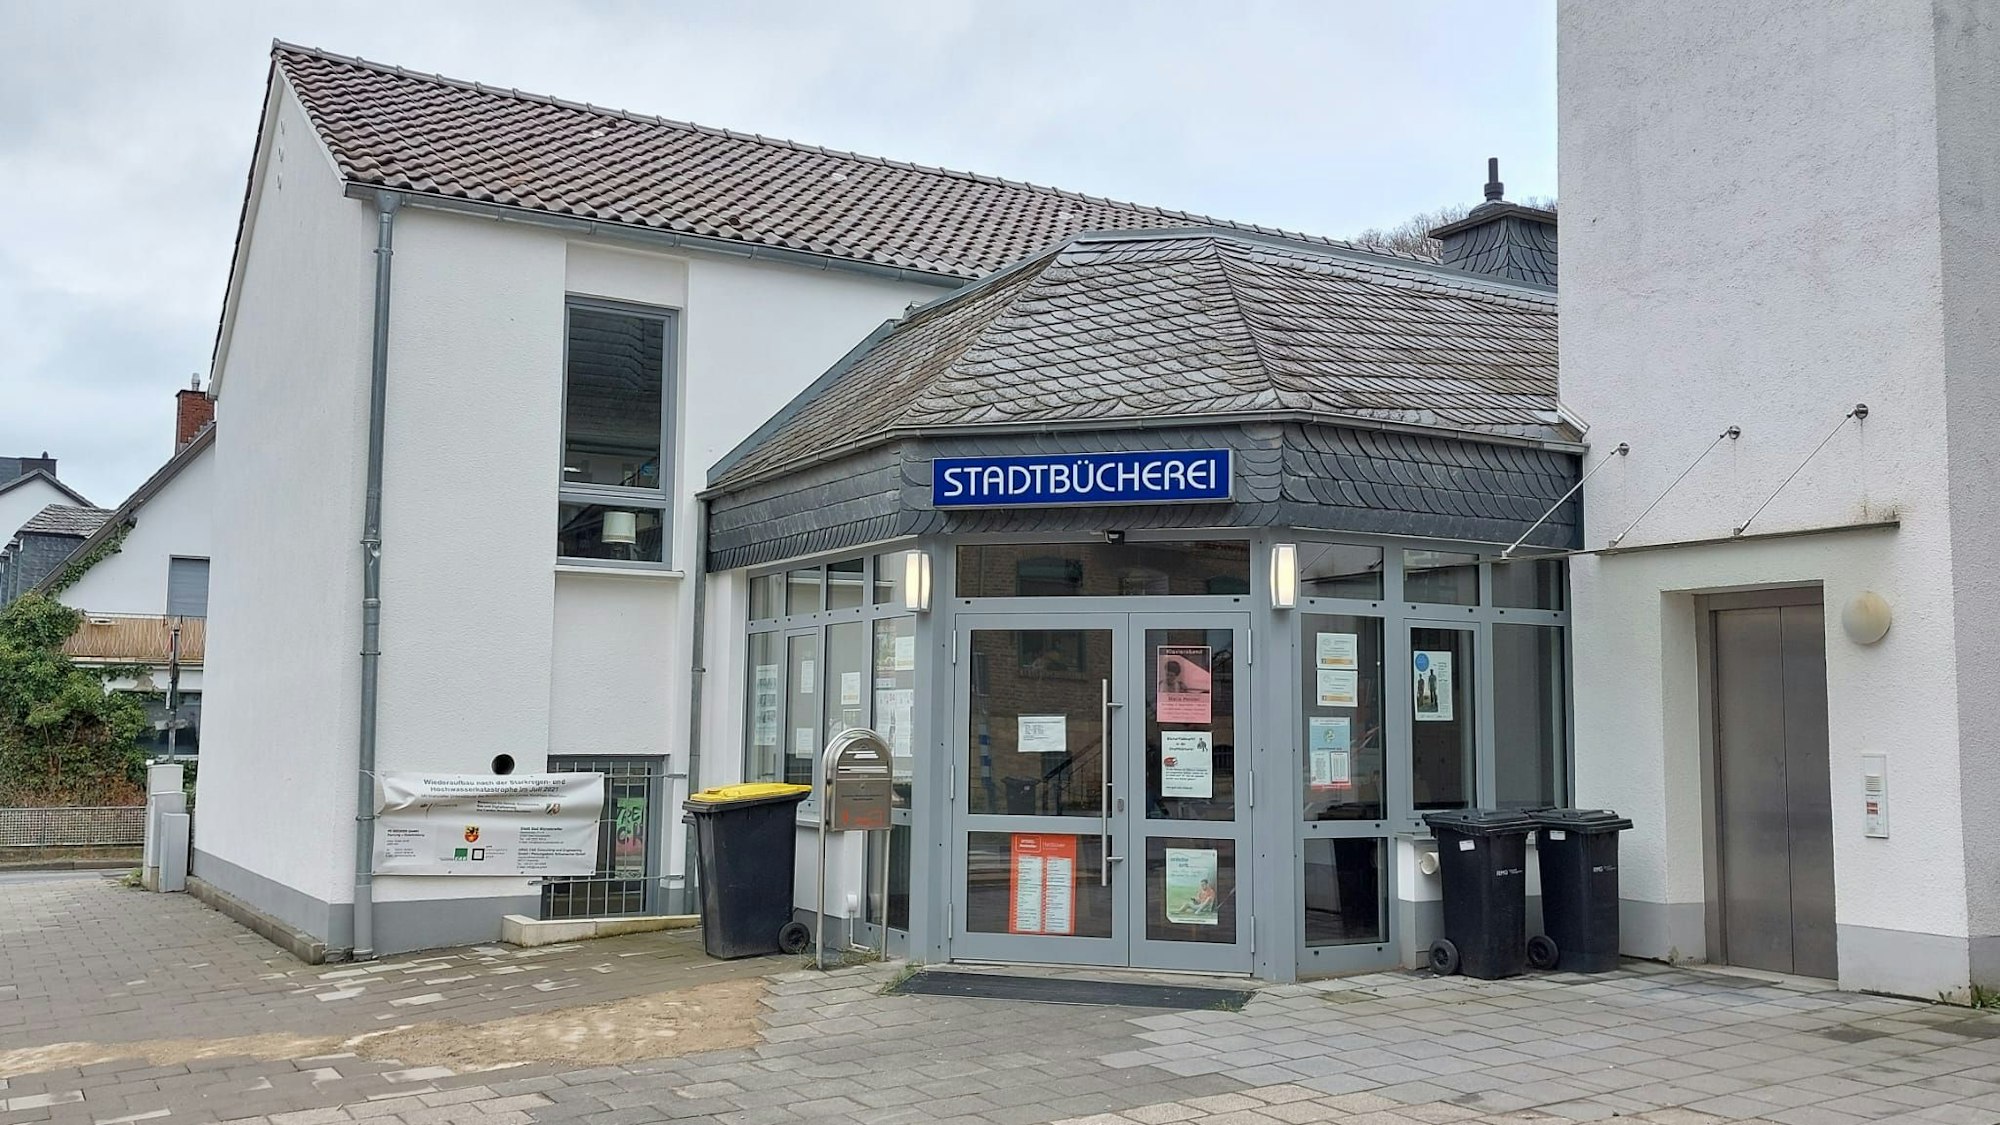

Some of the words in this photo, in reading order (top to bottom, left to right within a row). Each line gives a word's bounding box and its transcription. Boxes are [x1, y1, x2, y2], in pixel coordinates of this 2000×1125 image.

[943, 459, 1216, 497] STADTBÜCHEREI
[423, 778, 475, 786] Wiederaufbau
[430, 786, 518, 794] Hochwasserkatastrophe
